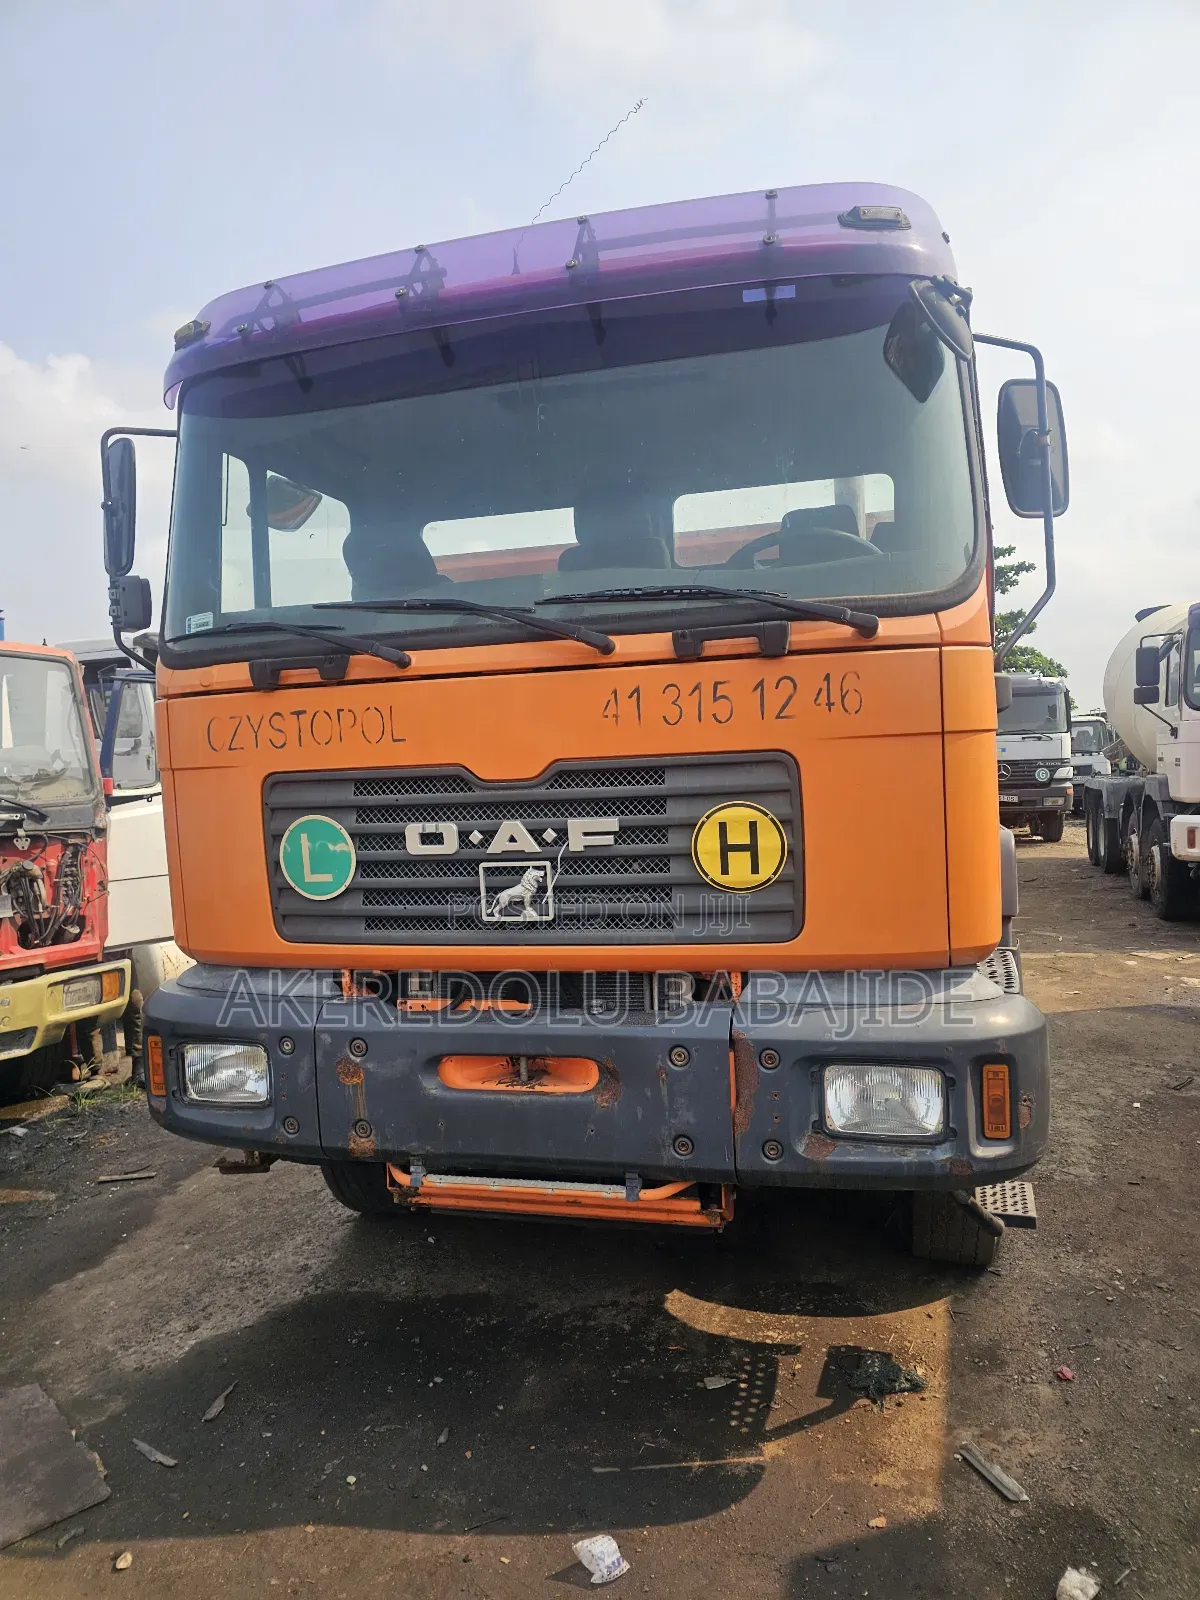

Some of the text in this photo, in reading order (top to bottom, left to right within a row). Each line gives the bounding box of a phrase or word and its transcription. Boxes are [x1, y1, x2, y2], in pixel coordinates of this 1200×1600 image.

[602, 670, 863, 727] 41 315 12 46
[206, 705, 407, 752] CZYSTOPOL
[299, 832, 334, 883] L
[717, 820, 760, 875] H
